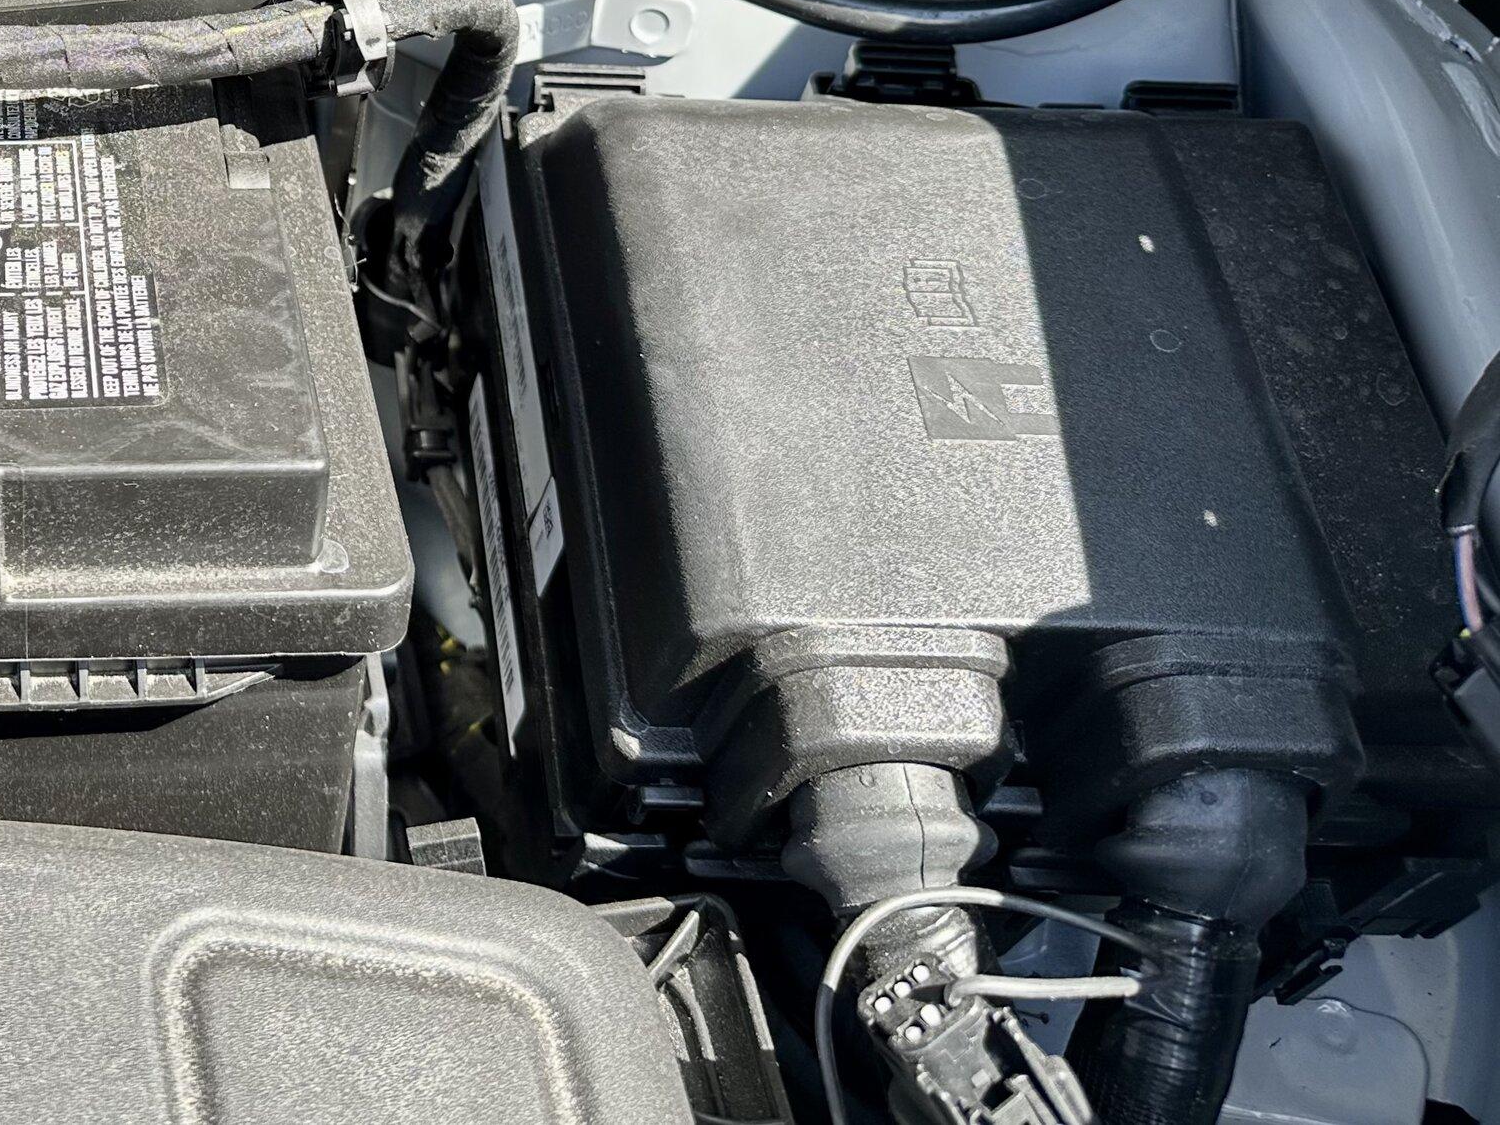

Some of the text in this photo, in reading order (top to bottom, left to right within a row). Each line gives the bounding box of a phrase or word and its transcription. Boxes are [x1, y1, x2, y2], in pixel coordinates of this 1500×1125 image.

[84, 177, 100, 191] NOT
[0, 183, 14, 209] SEVERE
[85, 192, 100, 202] DO
[104, 200, 121, 215] PAS
[0, 211, 15, 221] OR
[105, 216, 122, 227] NE
[86, 219, 104, 233] NOT
[88, 235, 106, 246] DO
[6, 248, 22, 260] LES
[61, 253, 78, 287] DE FUMER
[112, 268, 127, 284] DES
[44, 275, 60, 287] LES
[95, 289, 110, 299] OF
[111, 285, 132, 317] PORTÉE
[64, 298, 82, 327] AVEUGLE
[96, 300, 114, 326] REACH
[116, 318, 132, 329] LA
[135, 317, 152, 328] LA
[98, 328, 115, 343] THE
[118, 331, 134, 342] DE
[24, 299, 48, 399] PROTÉGEZ LES YEUX LES
[46, 306, 68, 398] GAZ EXPLOSIFS PEUVENT
[99, 345, 117, 356] OF
[137, 330, 155, 362] OUVRIR
[3, 311, 22, 400] BLINDNESS OR INJURY
[68, 356, 85, 366] OU
[120, 344, 136, 368] HORS
[101, 357, 118, 374] OUT
[140, 364, 158, 382] PAS
[69, 367, 88, 398] BLESSER
[102, 375, 121, 397] KEEP
[122, 370, 140, 396] TENIR
[142, 383, 160, 396] NE
